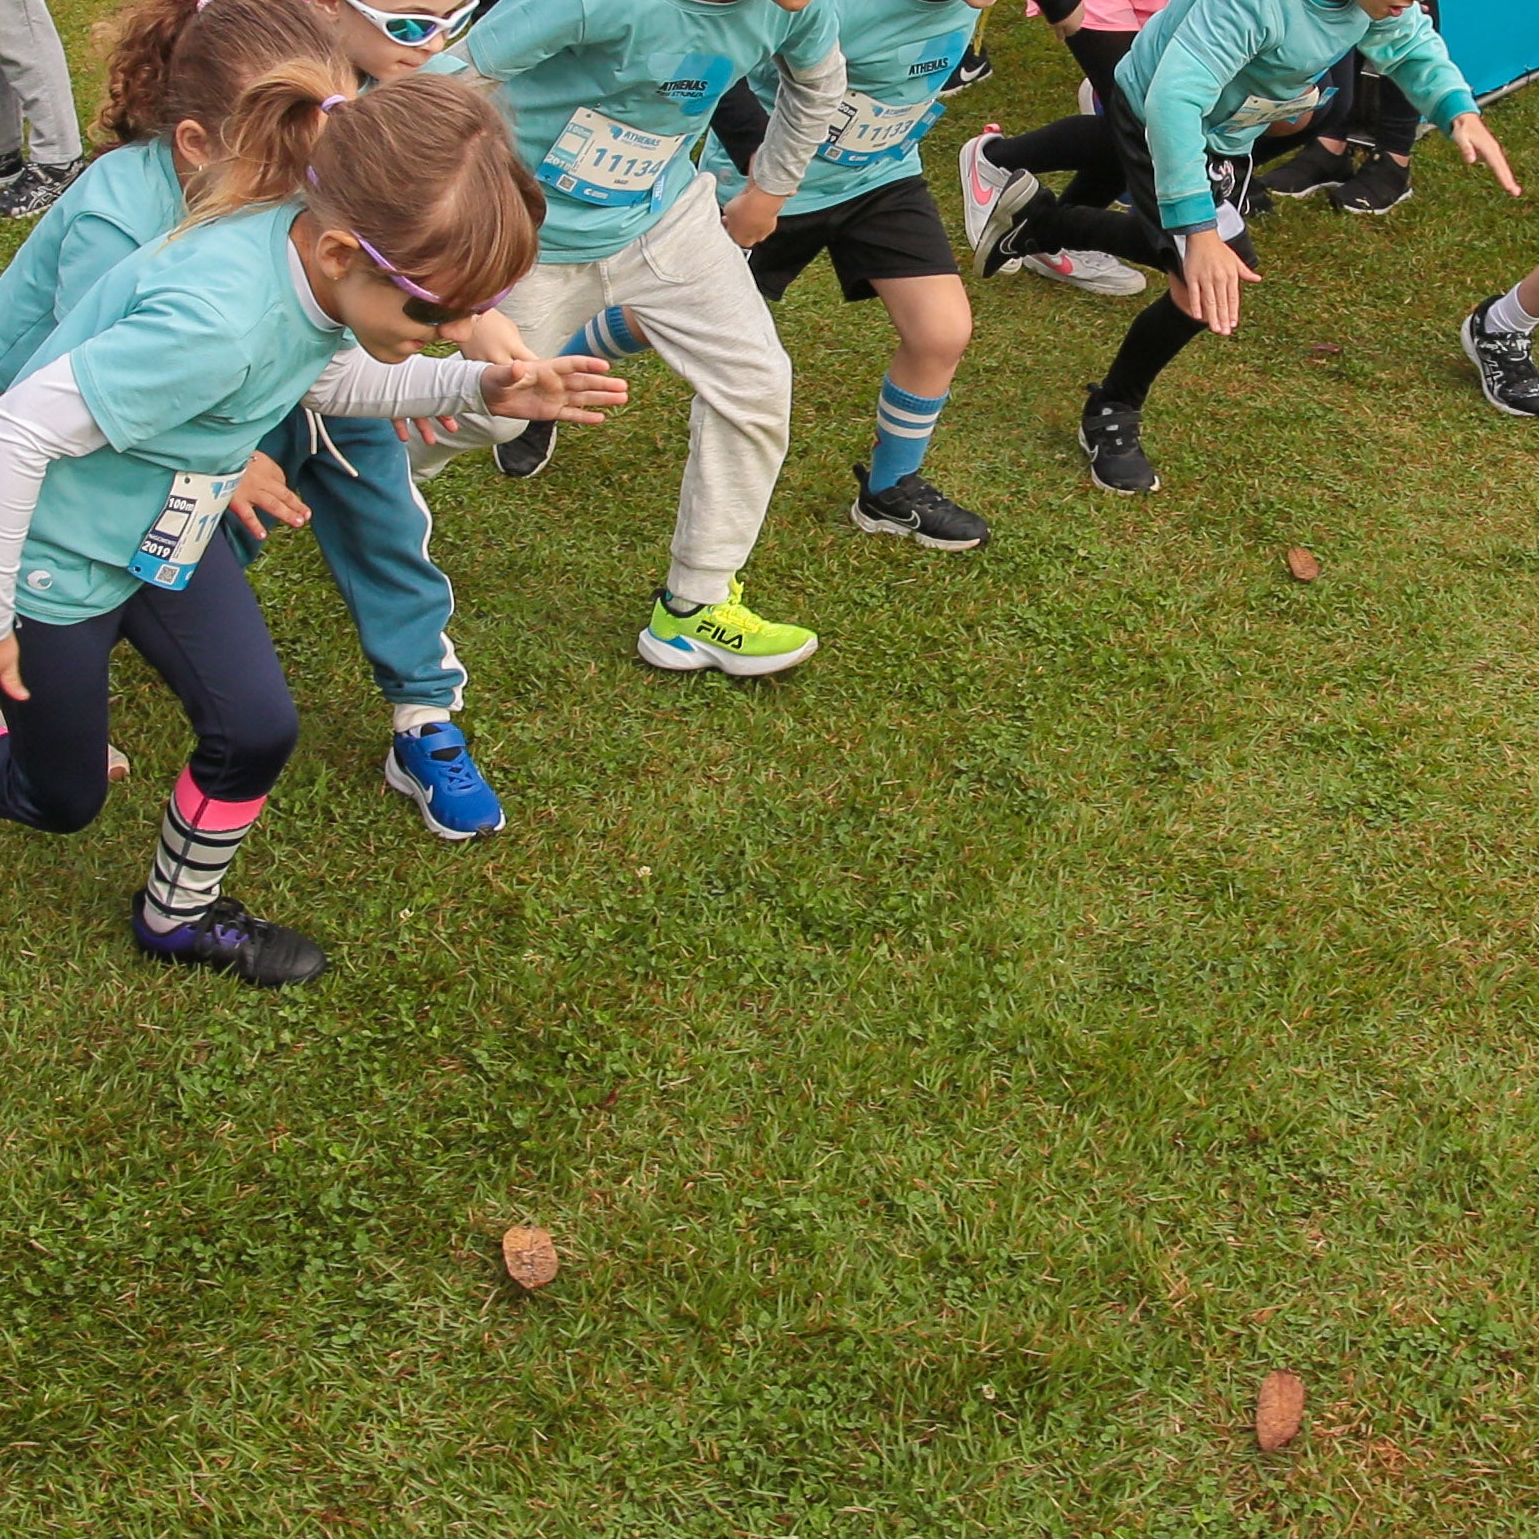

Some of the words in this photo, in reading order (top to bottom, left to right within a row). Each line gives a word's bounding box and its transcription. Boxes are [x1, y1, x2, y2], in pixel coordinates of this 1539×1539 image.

[908, 58, 949, 76] ATHENAS
[658, 79, 708, 92] ATHENAS
[624, 130, 661, 147] ATHENAS
[592, 148, 665, 178] 11134
[168, 497, 195, 512] 100m
[141, 540, 171, 557] 2019
[696, 620, 743, 650] FILA
